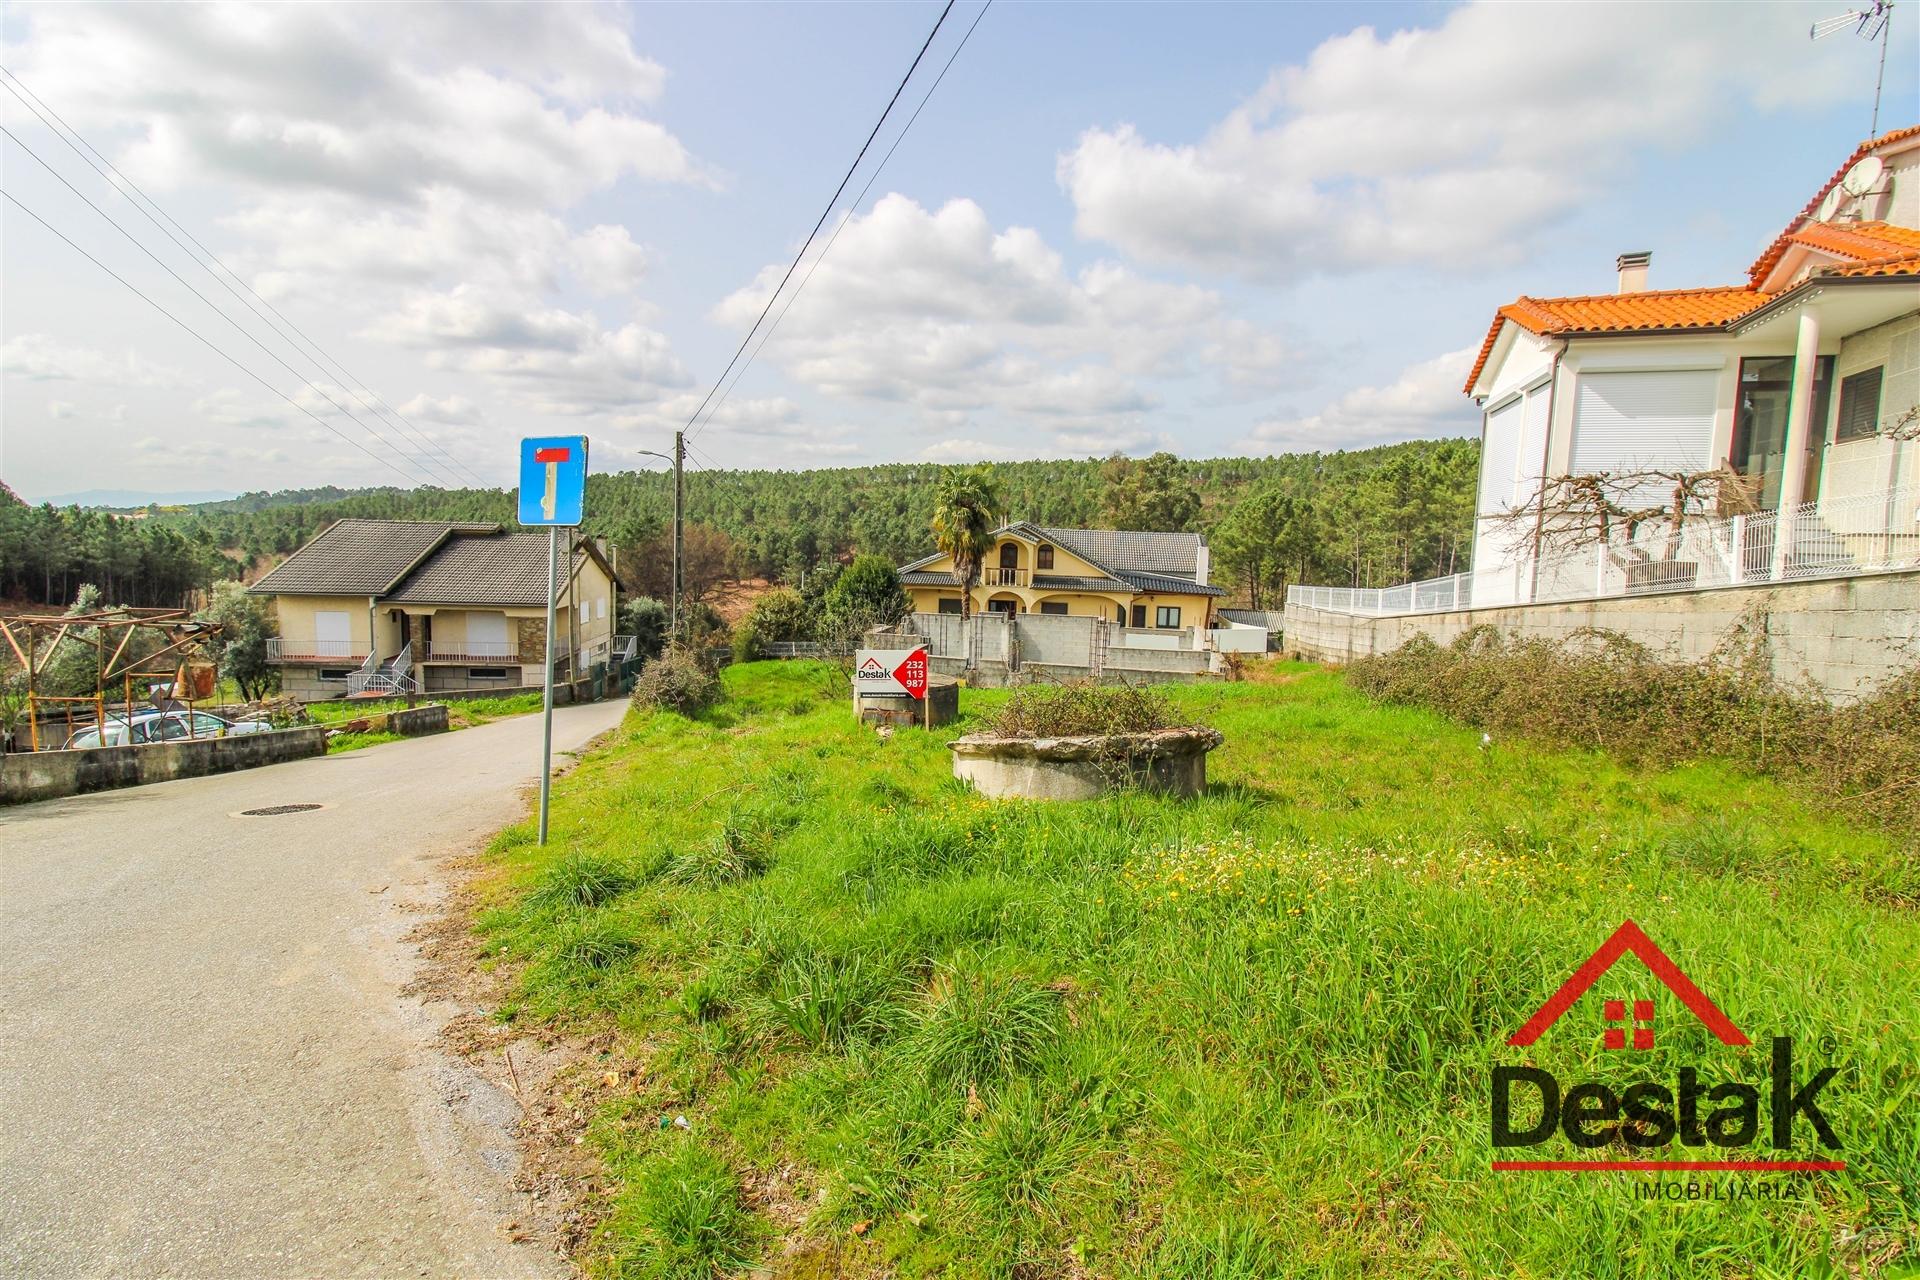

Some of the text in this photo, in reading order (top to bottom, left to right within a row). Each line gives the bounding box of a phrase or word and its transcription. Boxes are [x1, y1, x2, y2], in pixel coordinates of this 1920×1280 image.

[906, 661, 924, 669] 232
[858, 668, 891, 679] Destak
[906, 670, 924, 678] 113
[906, 679, 924, 688] 987
